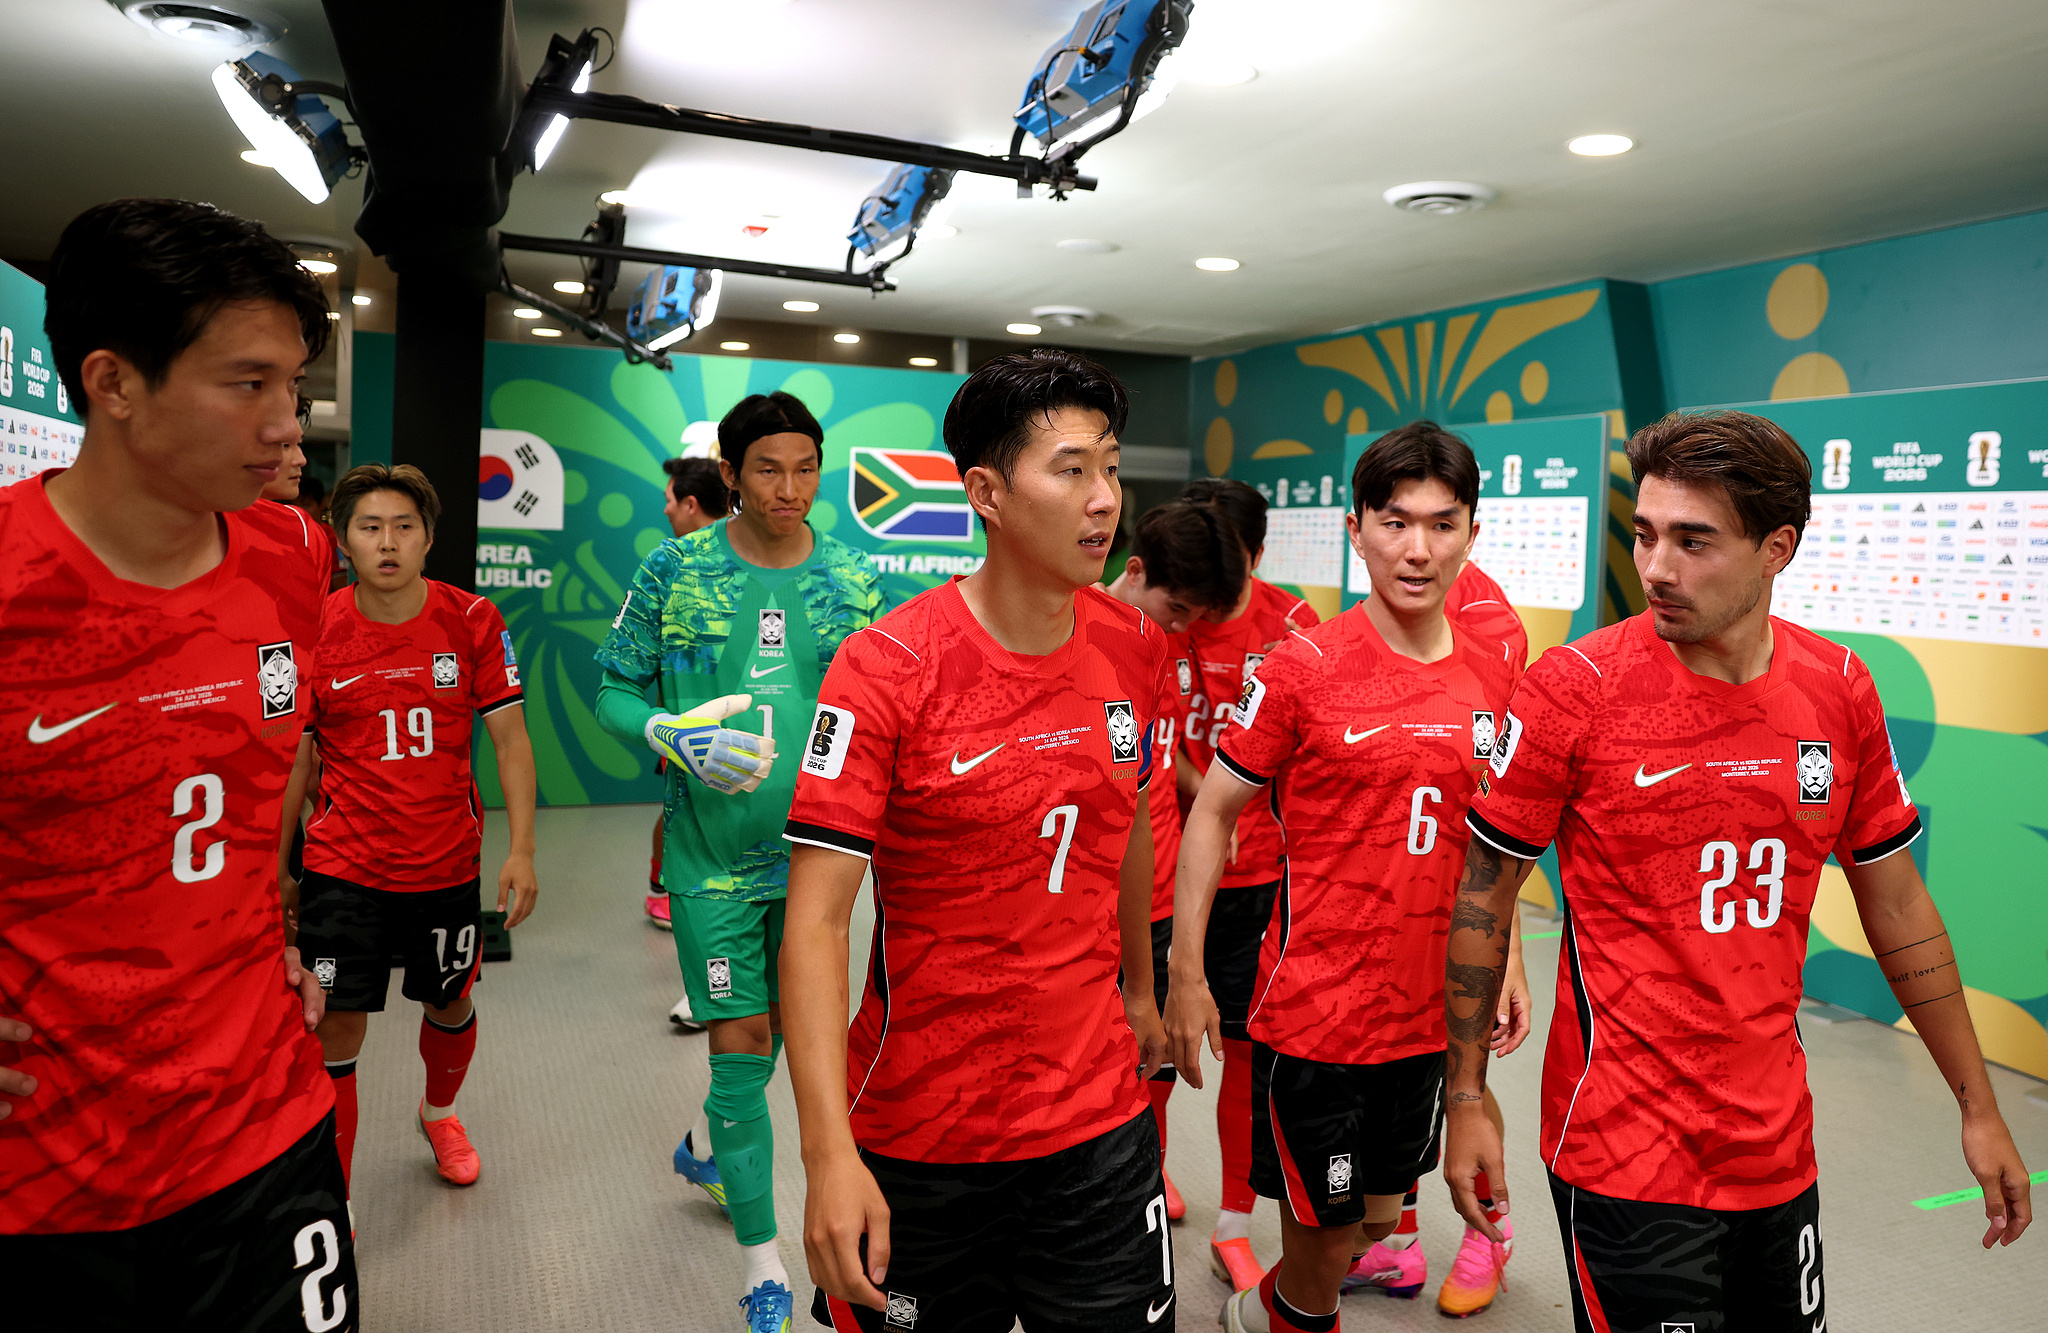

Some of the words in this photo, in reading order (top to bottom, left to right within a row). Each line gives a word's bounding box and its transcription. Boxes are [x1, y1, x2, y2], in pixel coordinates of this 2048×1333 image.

[31, 347, 42, 364] FIFA
[22, 360, 40, 380] WORLD
[28, 380, 45, 398] 2026
[1893, 441, 1920, 455] FIFA
[1872, 455, 1916, 469] WORLD
[1916, 453, 1943, 468] CUP
[1883, 467, 1928, 482] 2026
[476, 544, 534, 565] REA
[138, 693, 162, 703] SOUTH
[162, 689, 186, 698] AFRICA
[194, 684, 216, 693] KOREA
[215, 679, 244, 690] REPUBLIC
[202, 695, 227, 705] MEXICO
[756, 704, 779, 758] 1
[1185, 693, 1236, 749] 22
[378, 707, 433, 762] 19
[1018, 735, 1035, 743] SOUTH
[1034, 732, 1051, 740] AFRICA
[1070, 725, 1092, 734] REPUBLIC
[1034, 741, 1062, 751] MONTERREY,
[1061, 738, 1080, 746] MEXICO
[1407, 786, 1443, 855] 6
[1795, 810, 1827, 821] KOREA
[170, 773, 228, 884] 2
[1038, 805, 1079, 894] 7
[1697, 838, 1787, 934] 23
[431, 924, 475, 973] 19
[1913, 967, 1936, 978] love
[710, 991, 733, 999] KOREA
[1327, 1194, 1351, 1205] KOREA
[1146, 1194, 1171, 1286] 7
[1798, 1207, 1822, 1316] 2
[292, 1219, 347, 1333] 2
